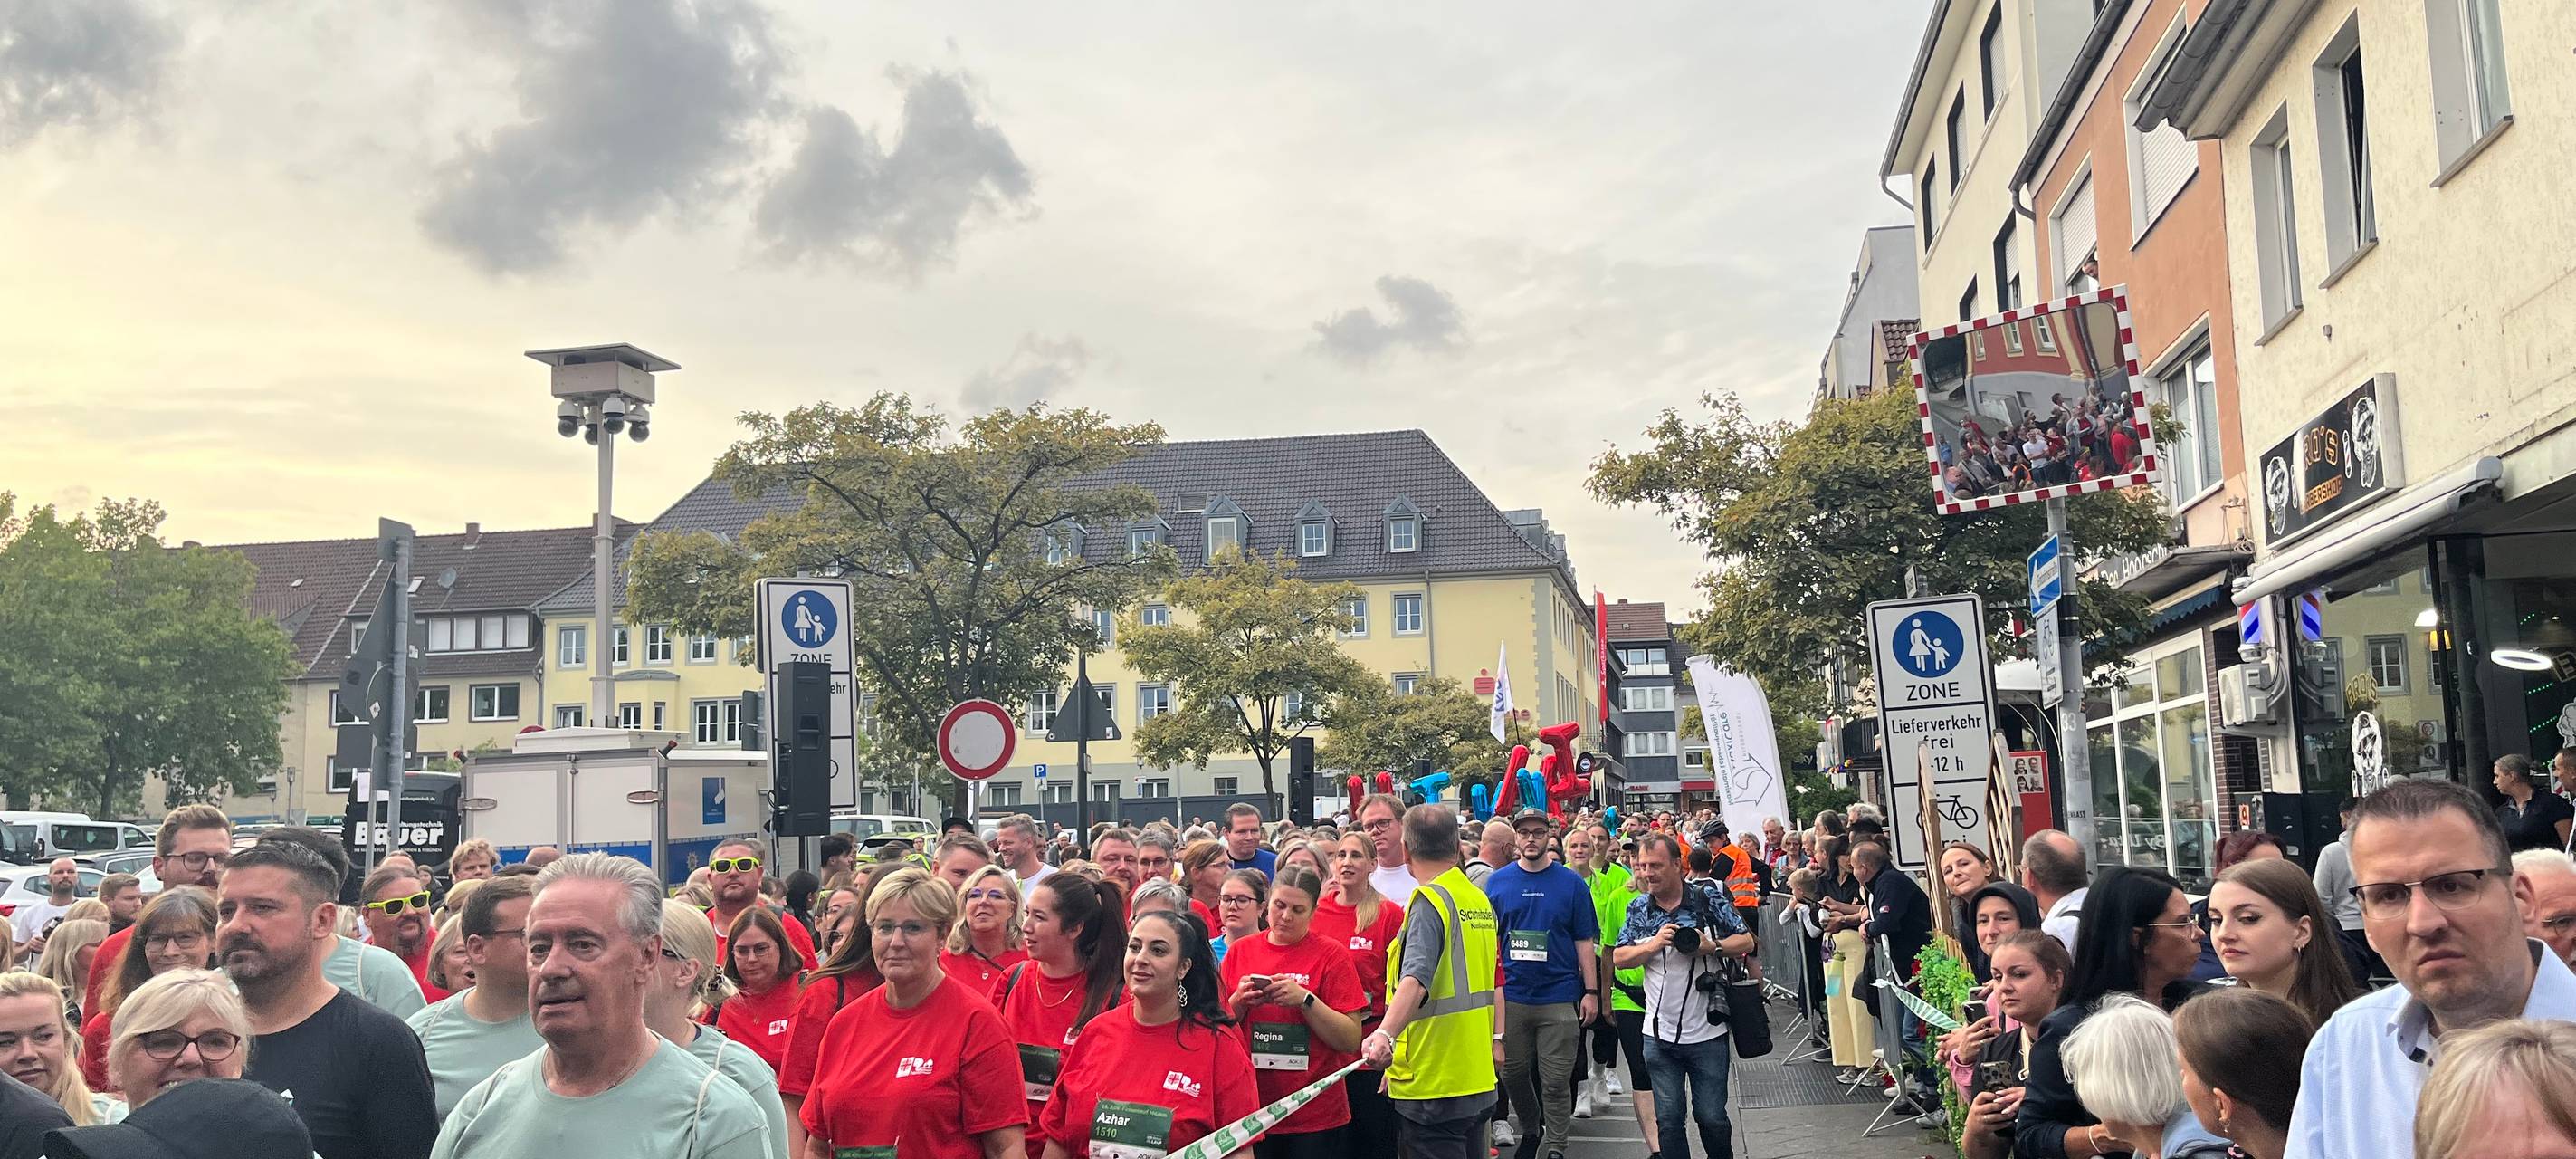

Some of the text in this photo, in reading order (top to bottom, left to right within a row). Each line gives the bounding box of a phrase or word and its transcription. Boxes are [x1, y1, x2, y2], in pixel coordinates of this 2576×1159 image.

[2303, 425, 2338, 471] RO'S
[790, 653, 832, 663] ZONE
[1905, 681, 1961, 702] ZONE
[2345, 673, 2378, 710] BRO'S
[1891, 714, 1982, 734] Lieferverkehr
[2060, 712, 2077, 732] 33
[1955, 755, 1964, 771] h
[354, 821, 444, 845] Bauer
[1511, 939, 1529, 949] 6489
[1254, 1031, 1283, 1042] Regina
[1096, 1112, 1131, 1126] Azhar
[1095, 1125, 1118, 1138] 1510
